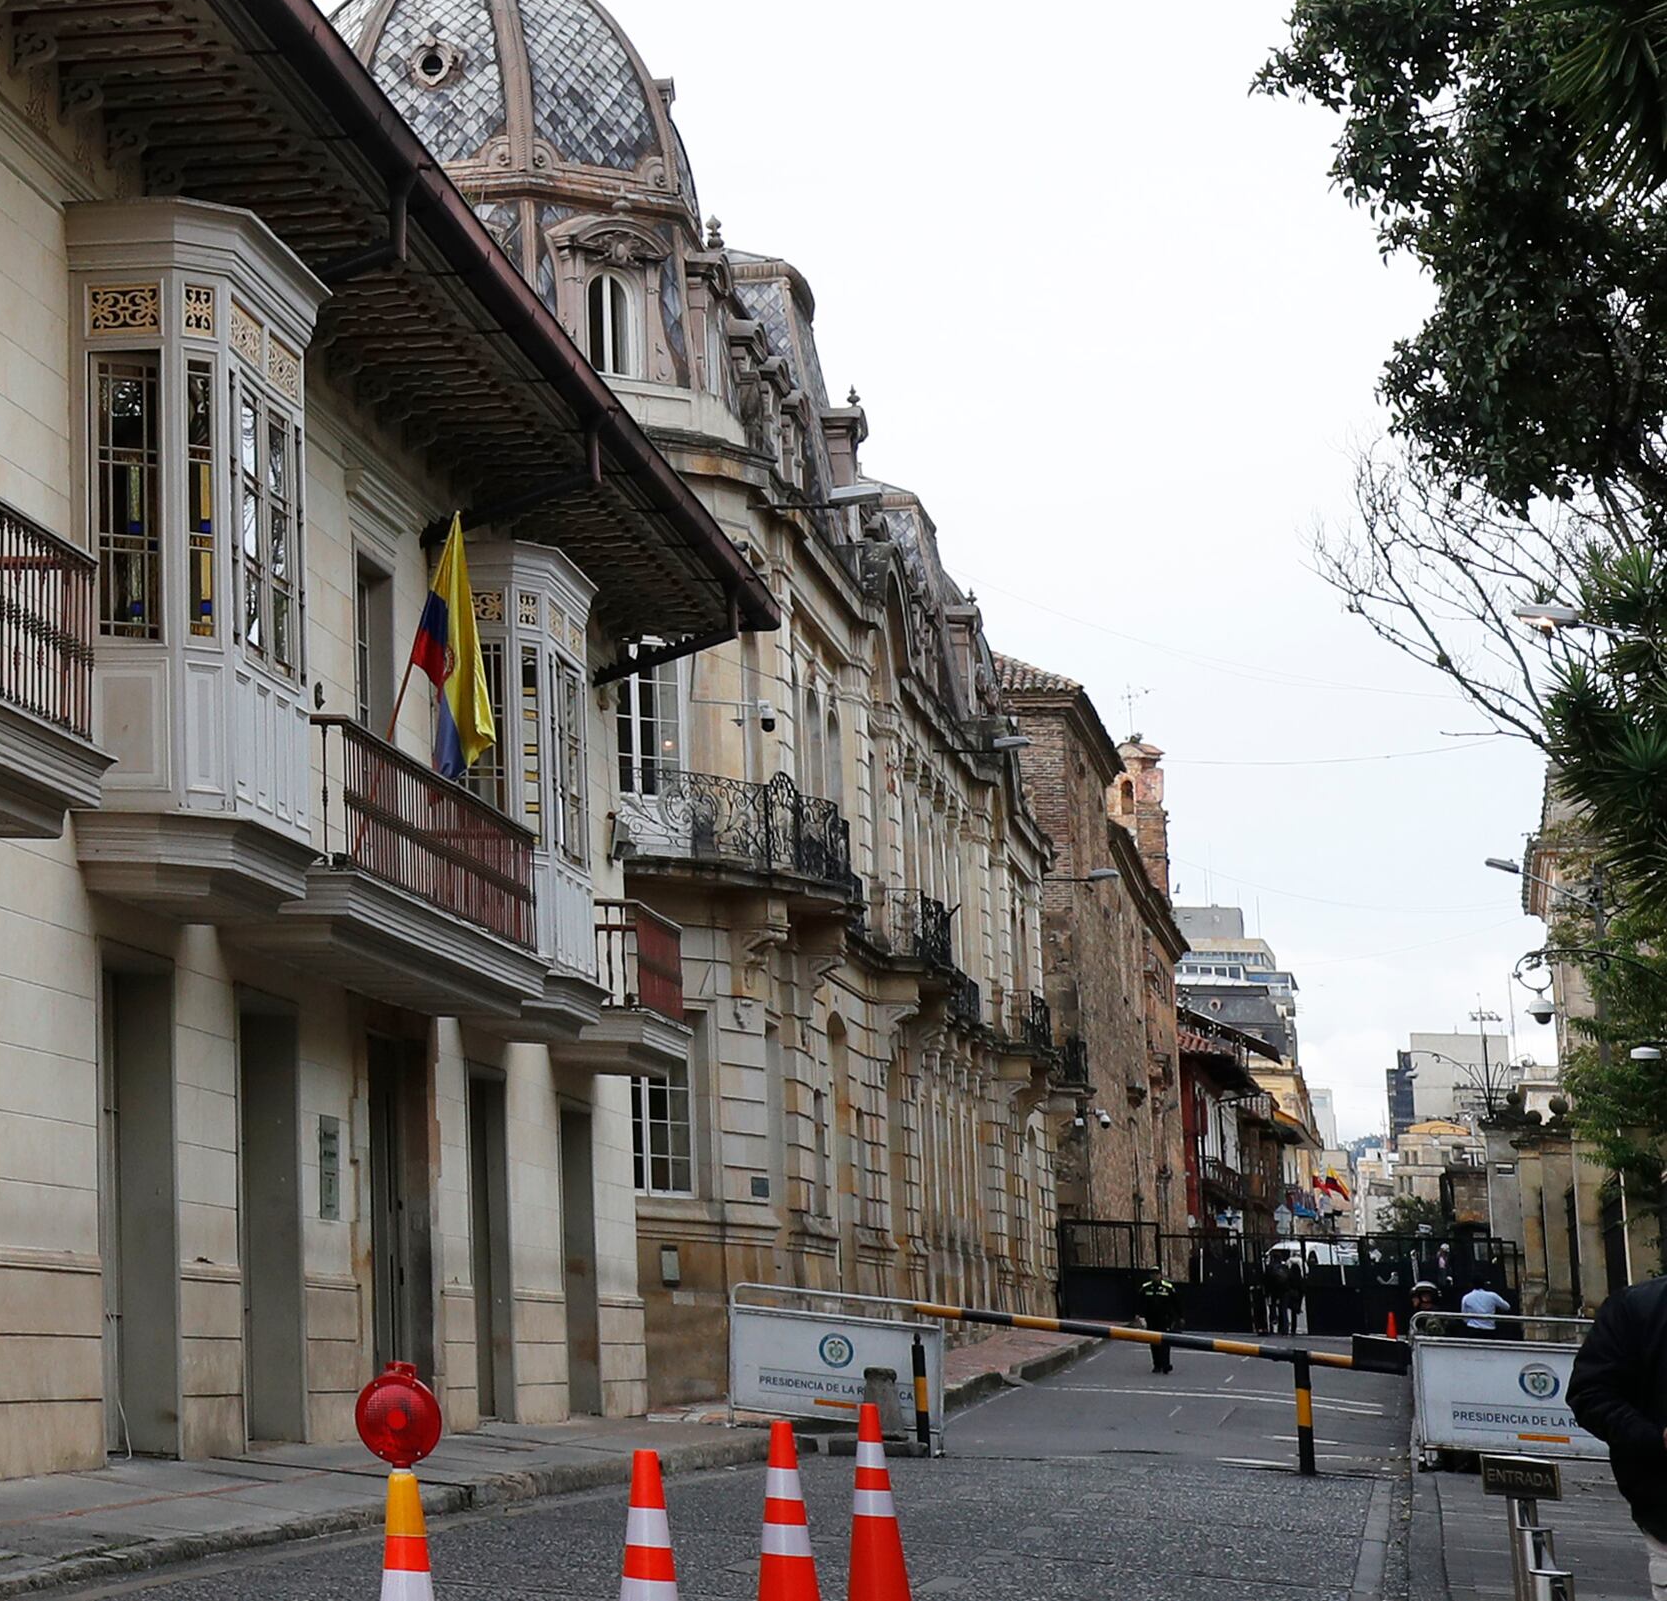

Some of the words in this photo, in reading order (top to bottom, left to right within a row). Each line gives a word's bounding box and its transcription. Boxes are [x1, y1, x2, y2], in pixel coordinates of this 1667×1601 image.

[759, 1375, 824, 1392] PRESIDENCIA
[826, 1383, 839, 1393] DE
[842, 1385, 854, 1395] LA
[1452, 1410, 1529, 1425] PRESIDENCIA
[1532, 1416, 1548, 1426] DE
[1551, 1417, 1565, 1427] LA
[1487, 1468, 1555, 1489] ENTRADA
